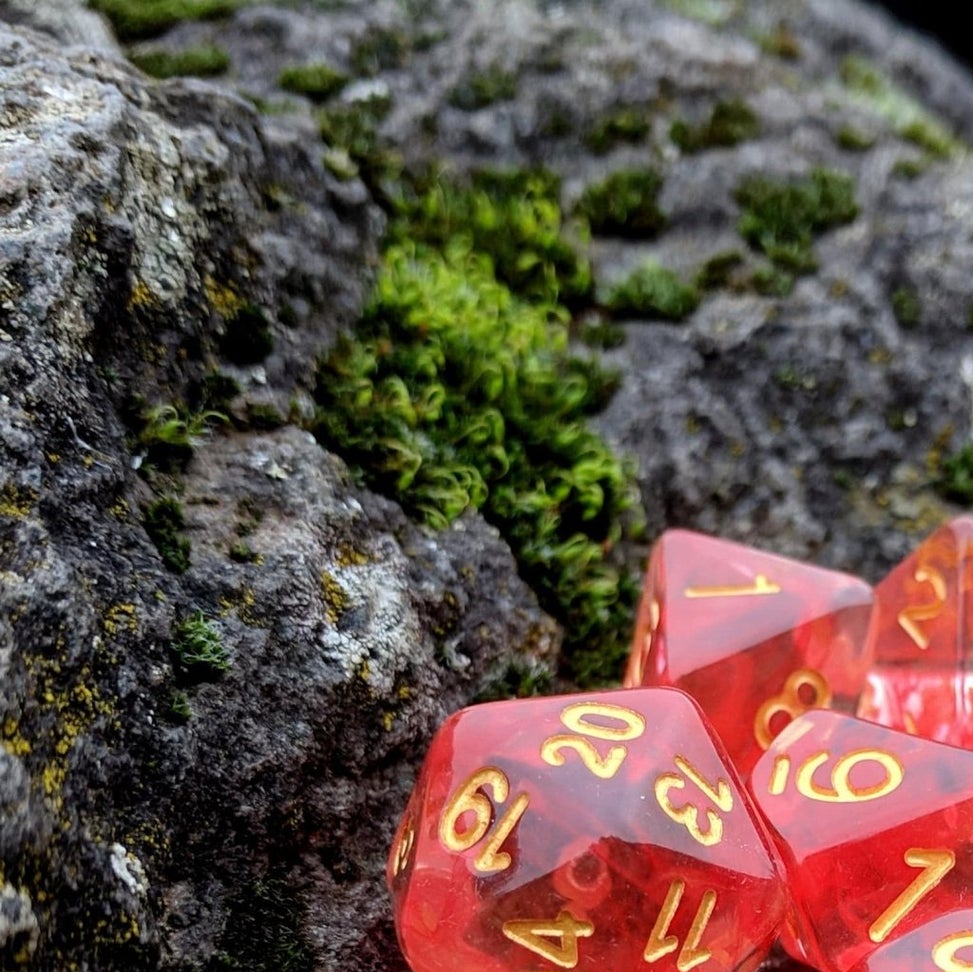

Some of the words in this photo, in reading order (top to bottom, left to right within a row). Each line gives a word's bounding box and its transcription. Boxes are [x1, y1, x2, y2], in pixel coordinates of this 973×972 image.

[684, 573, 781, 599] 1
[898, 564, 947, 650] 2
[541, 701, 646, 780] 20
[654, 754, 735, 847] 13
